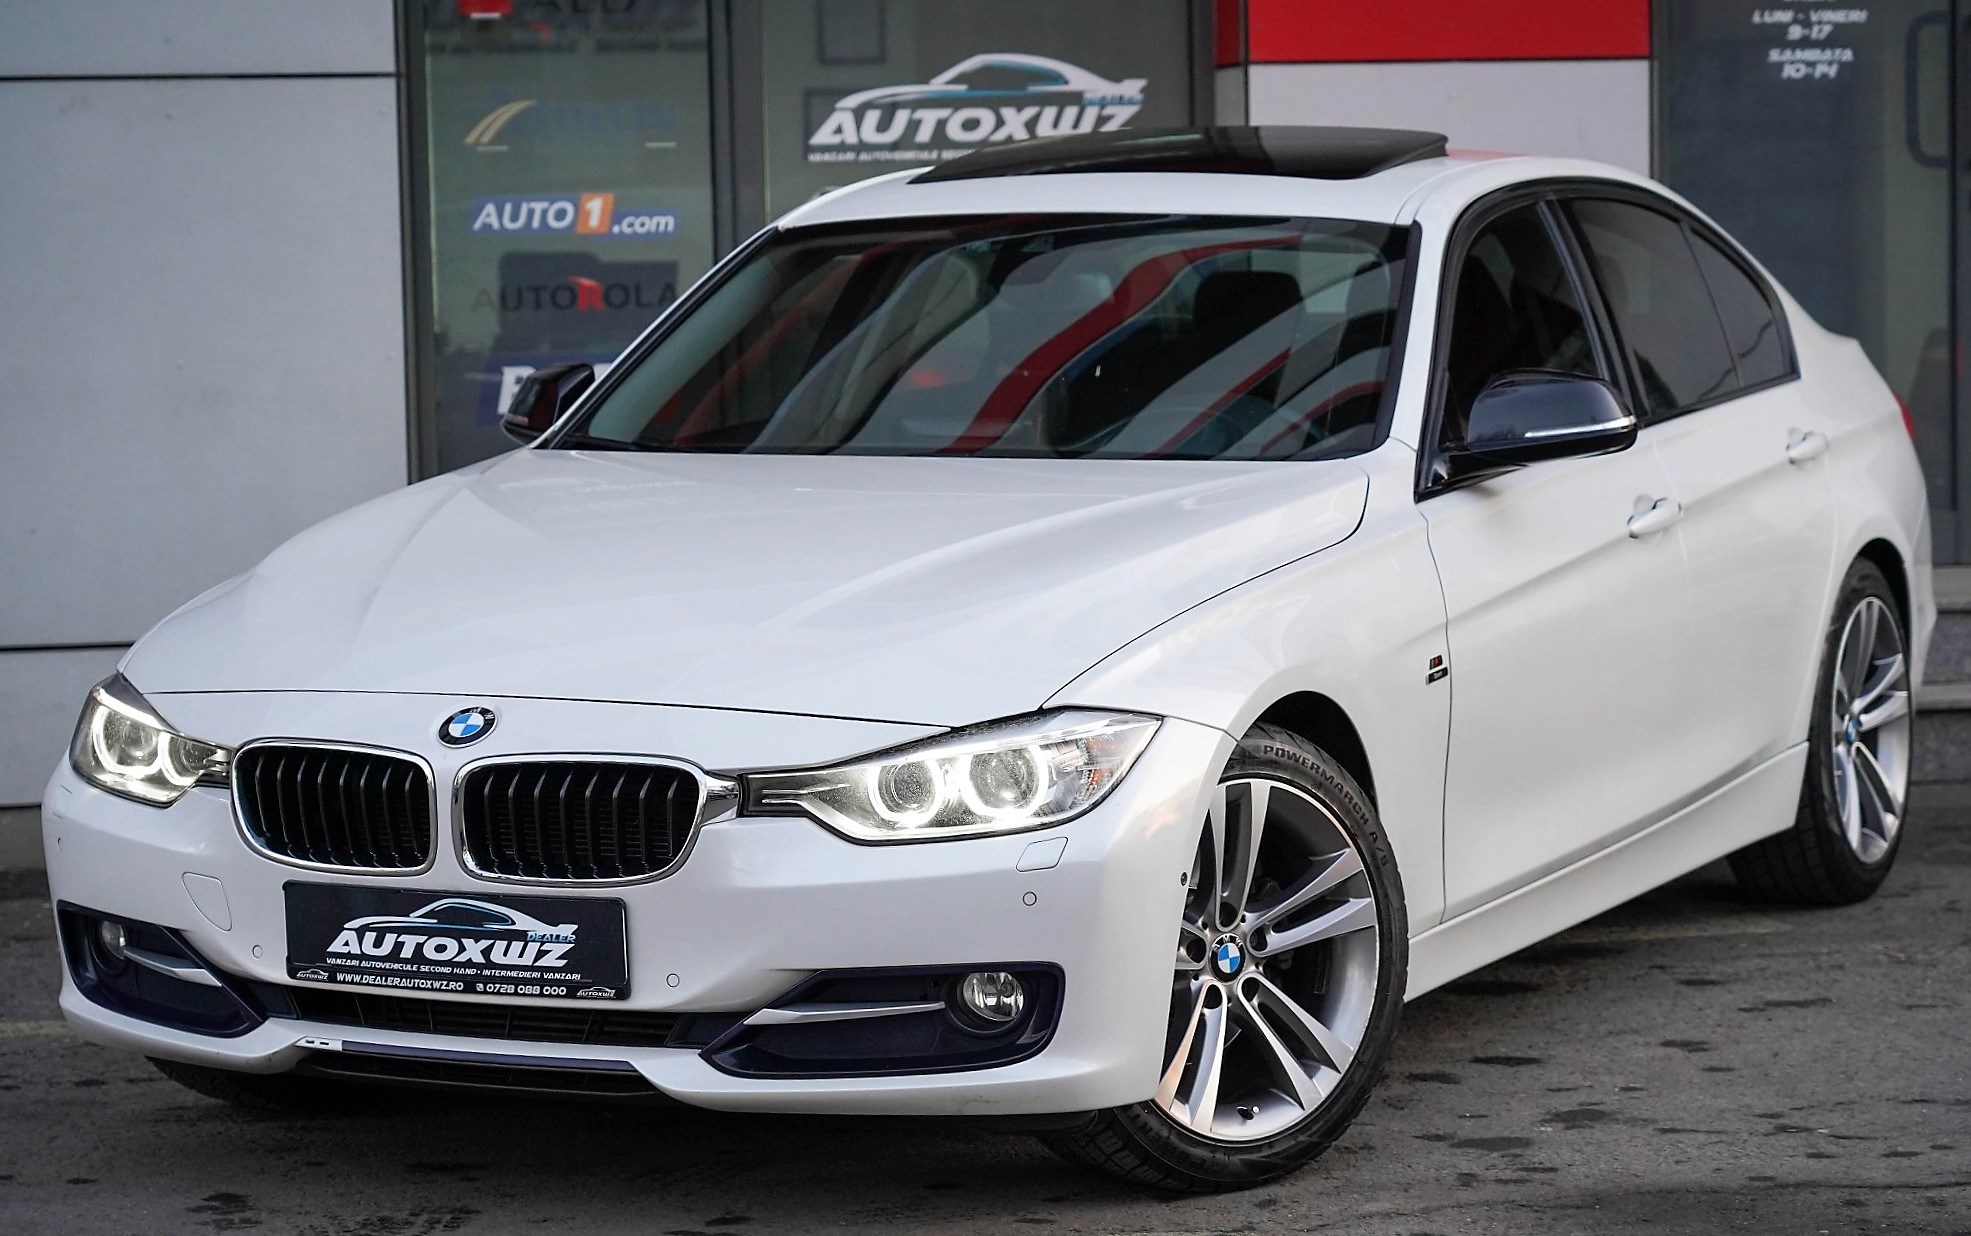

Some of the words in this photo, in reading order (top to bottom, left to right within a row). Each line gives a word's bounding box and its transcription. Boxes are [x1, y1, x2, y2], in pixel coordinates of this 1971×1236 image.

[1786, 23, 1834, 40] 9-17
[473, 196, 675, 235] AUTO1.com
[471, 275, 678, 313] AUTOROLA
[1263, 744, 1368, 826] POWERMARCH
[526, 931, 577, 944] DEALER
[325, 957, 359, 968] VANZARI
[360, 959, 418, 972] AUTOVEHICULE
[419, 964, 452, 975] SECOND
[453, 966, 477, 977] HAND
[482, 969, 541, 979] INTERMEDIERI
[543, 972, 581, 981] VANZARI
[336, 972, 464, 992] WWW.DEALERAUTOXWZ.RO
[486, 983, 515, 994] 0728
[544, 986, 567, 996] 000
